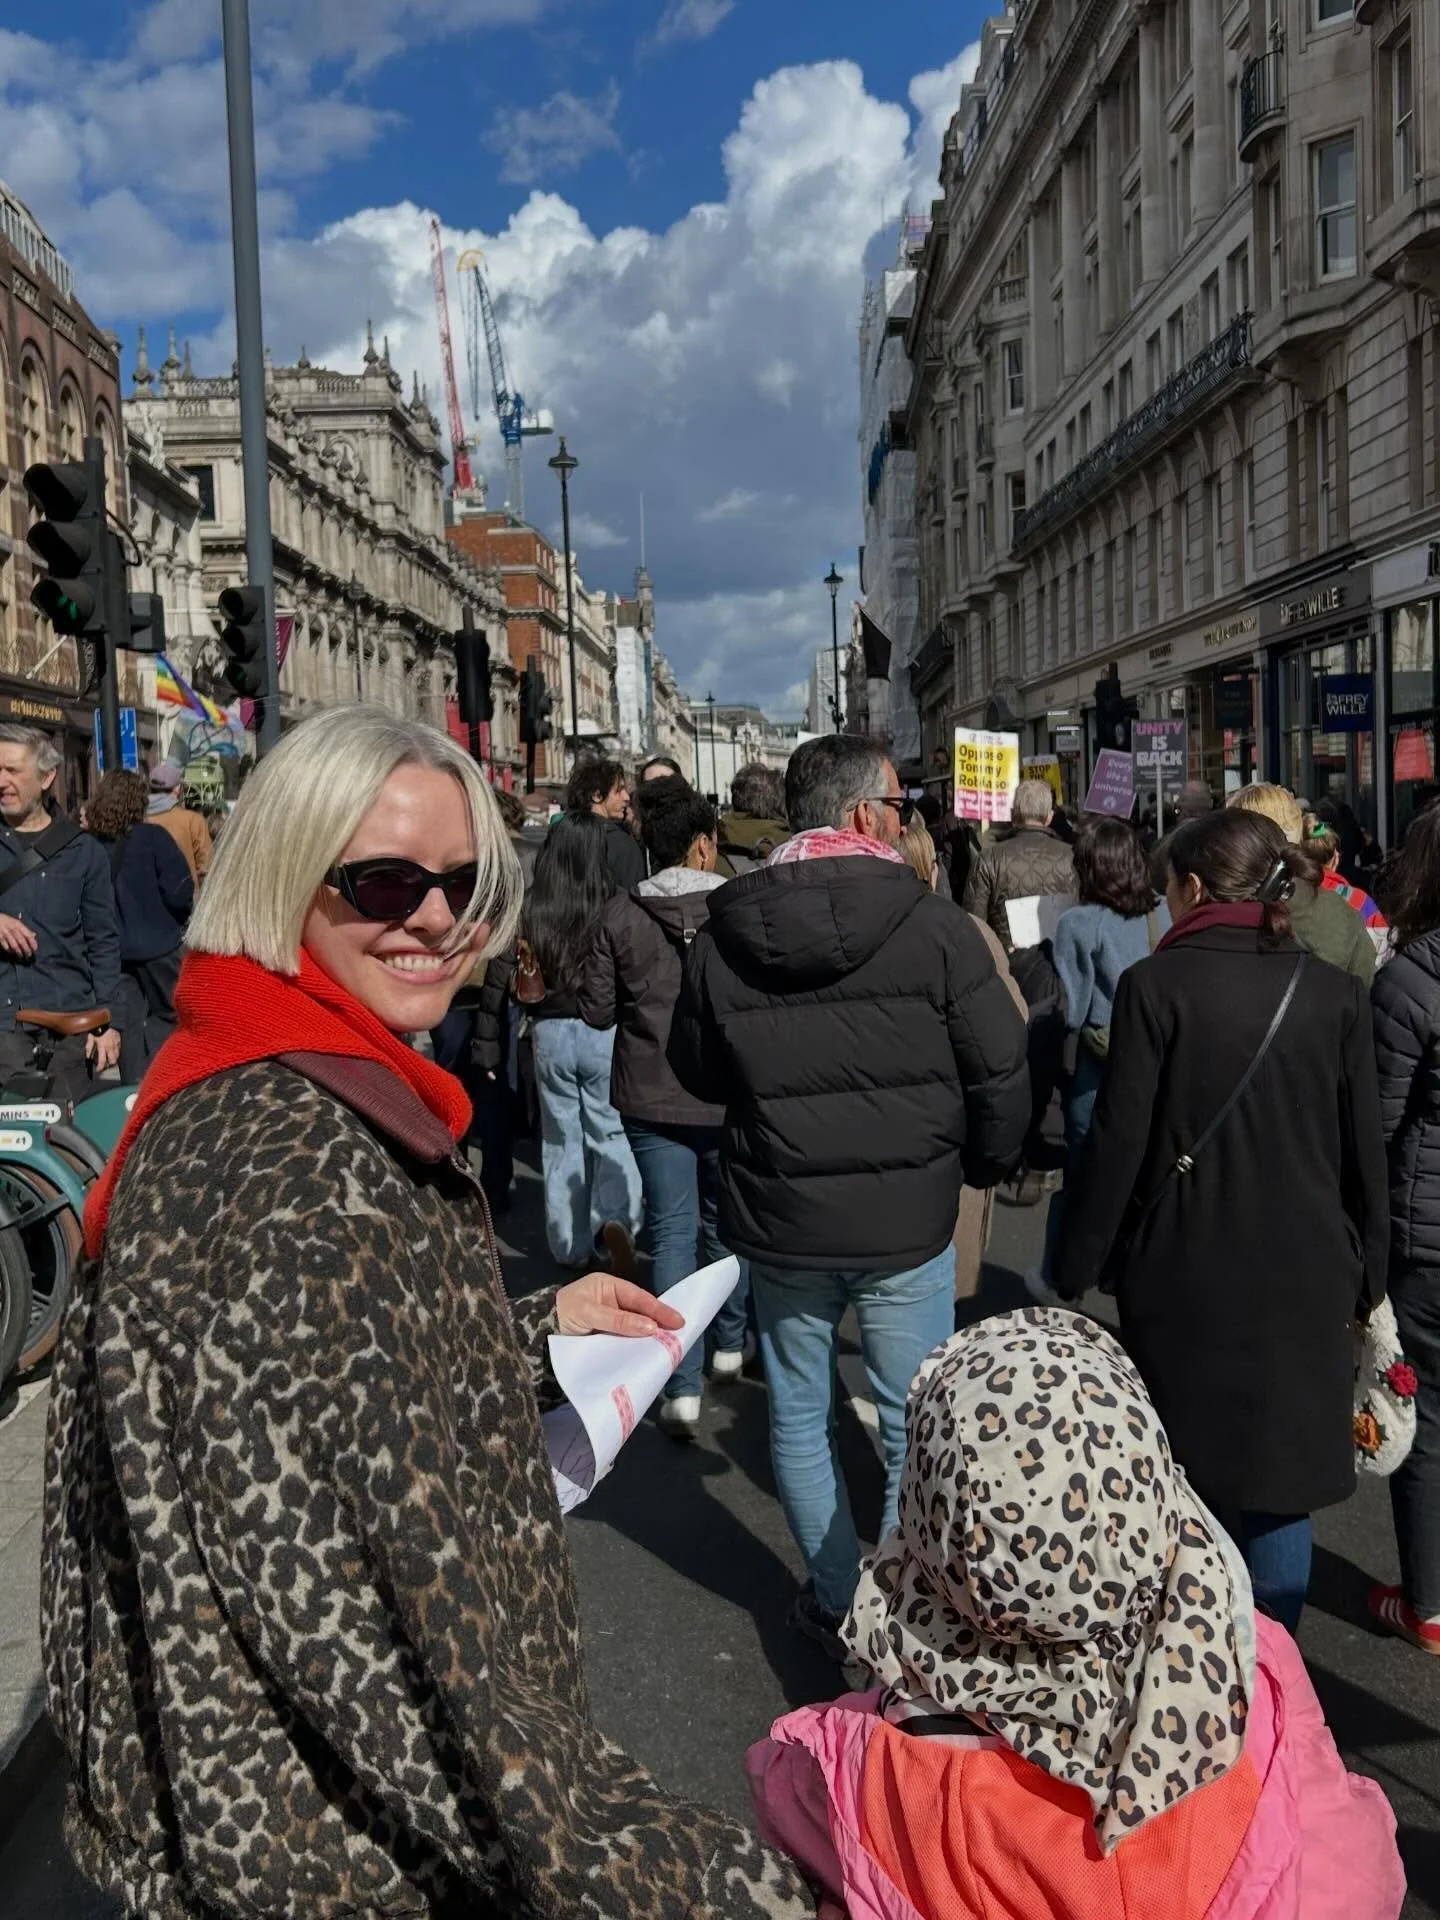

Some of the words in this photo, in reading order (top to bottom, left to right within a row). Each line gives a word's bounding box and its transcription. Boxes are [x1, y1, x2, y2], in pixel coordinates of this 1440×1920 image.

[1326, 704, 1367, 716] WILLE
[1136, 722, 1183, 735] UNITY
[1152, 735, 1168, 750] IS
[959, 744, 1004, 761] Oppose
[1136, 751, 1183, 767] BACK
[1029, 764, 1051, 776] STOP
